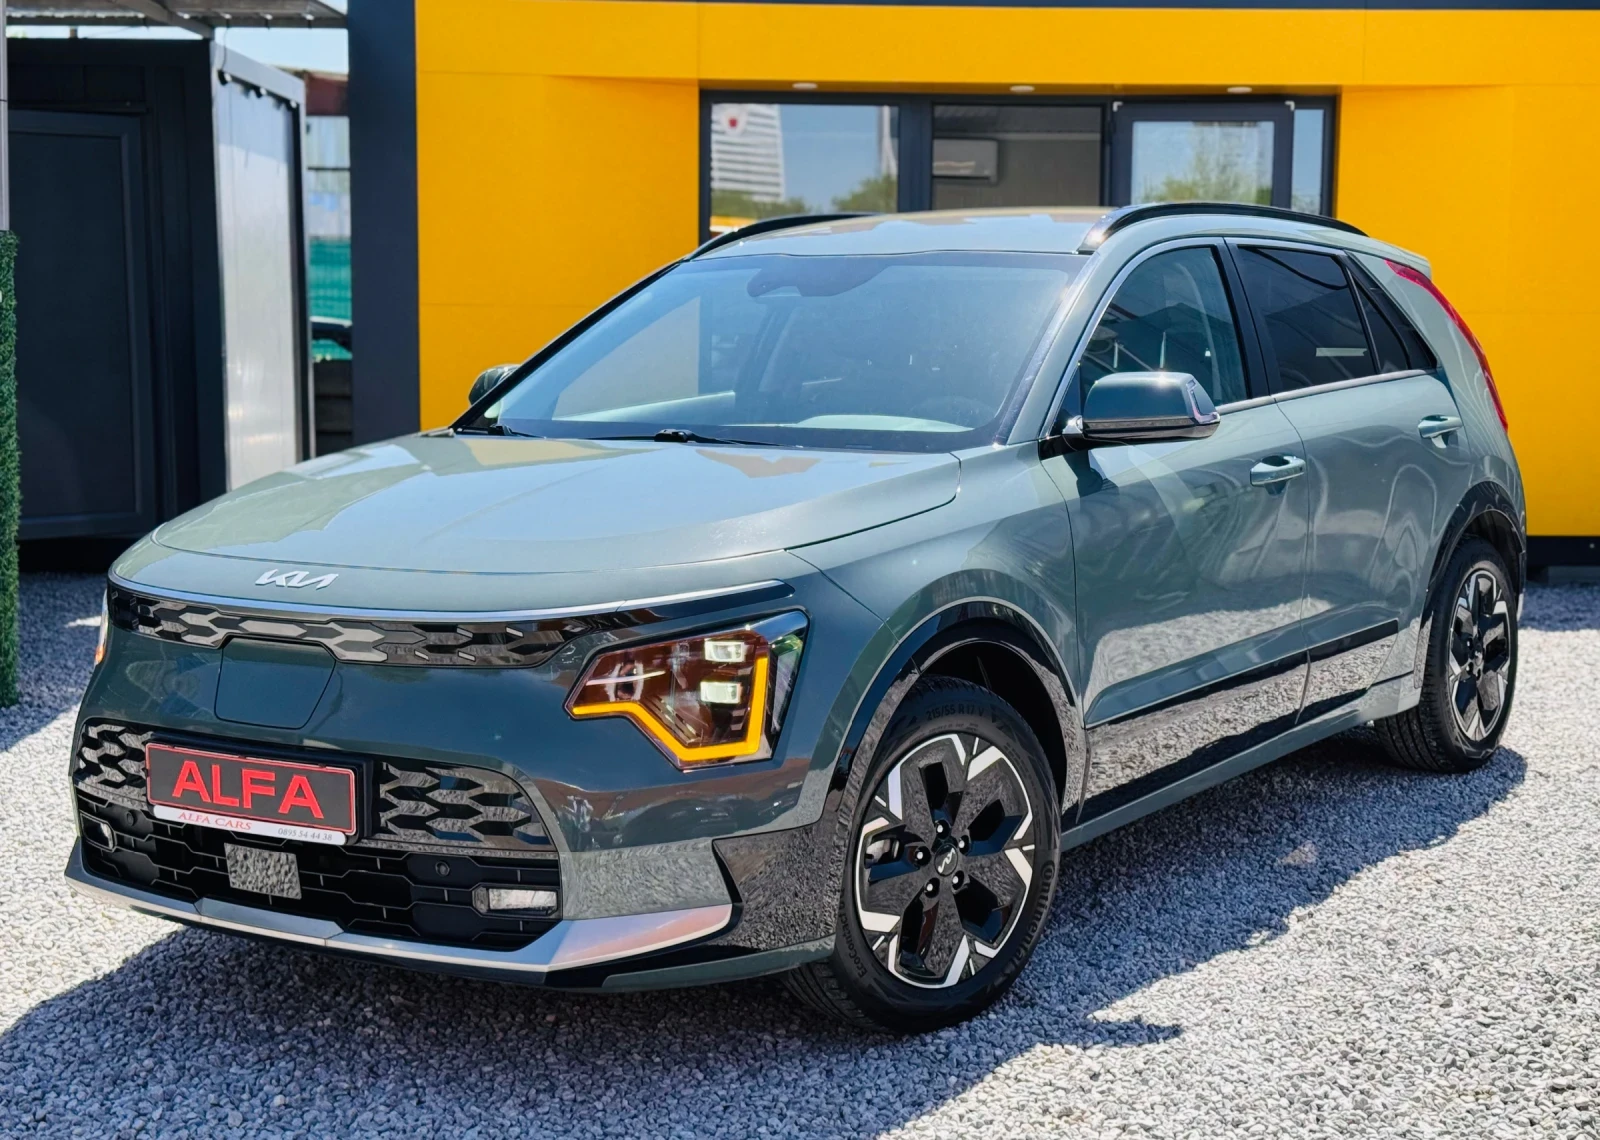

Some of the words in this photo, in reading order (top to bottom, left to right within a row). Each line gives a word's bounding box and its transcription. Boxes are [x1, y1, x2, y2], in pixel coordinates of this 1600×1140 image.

[254, 569, 339, 590] KIA
[171, 760, 325, 819] ALFA
[178, 811, 211, 825] ALFA
[214, 816, 253, 831] CARS
[277, 827, 297, 838] 0895
[298, 829, 309, 839] 54
[310, 831, 321, 840] 44
[322, 832, 333, 842] 38
